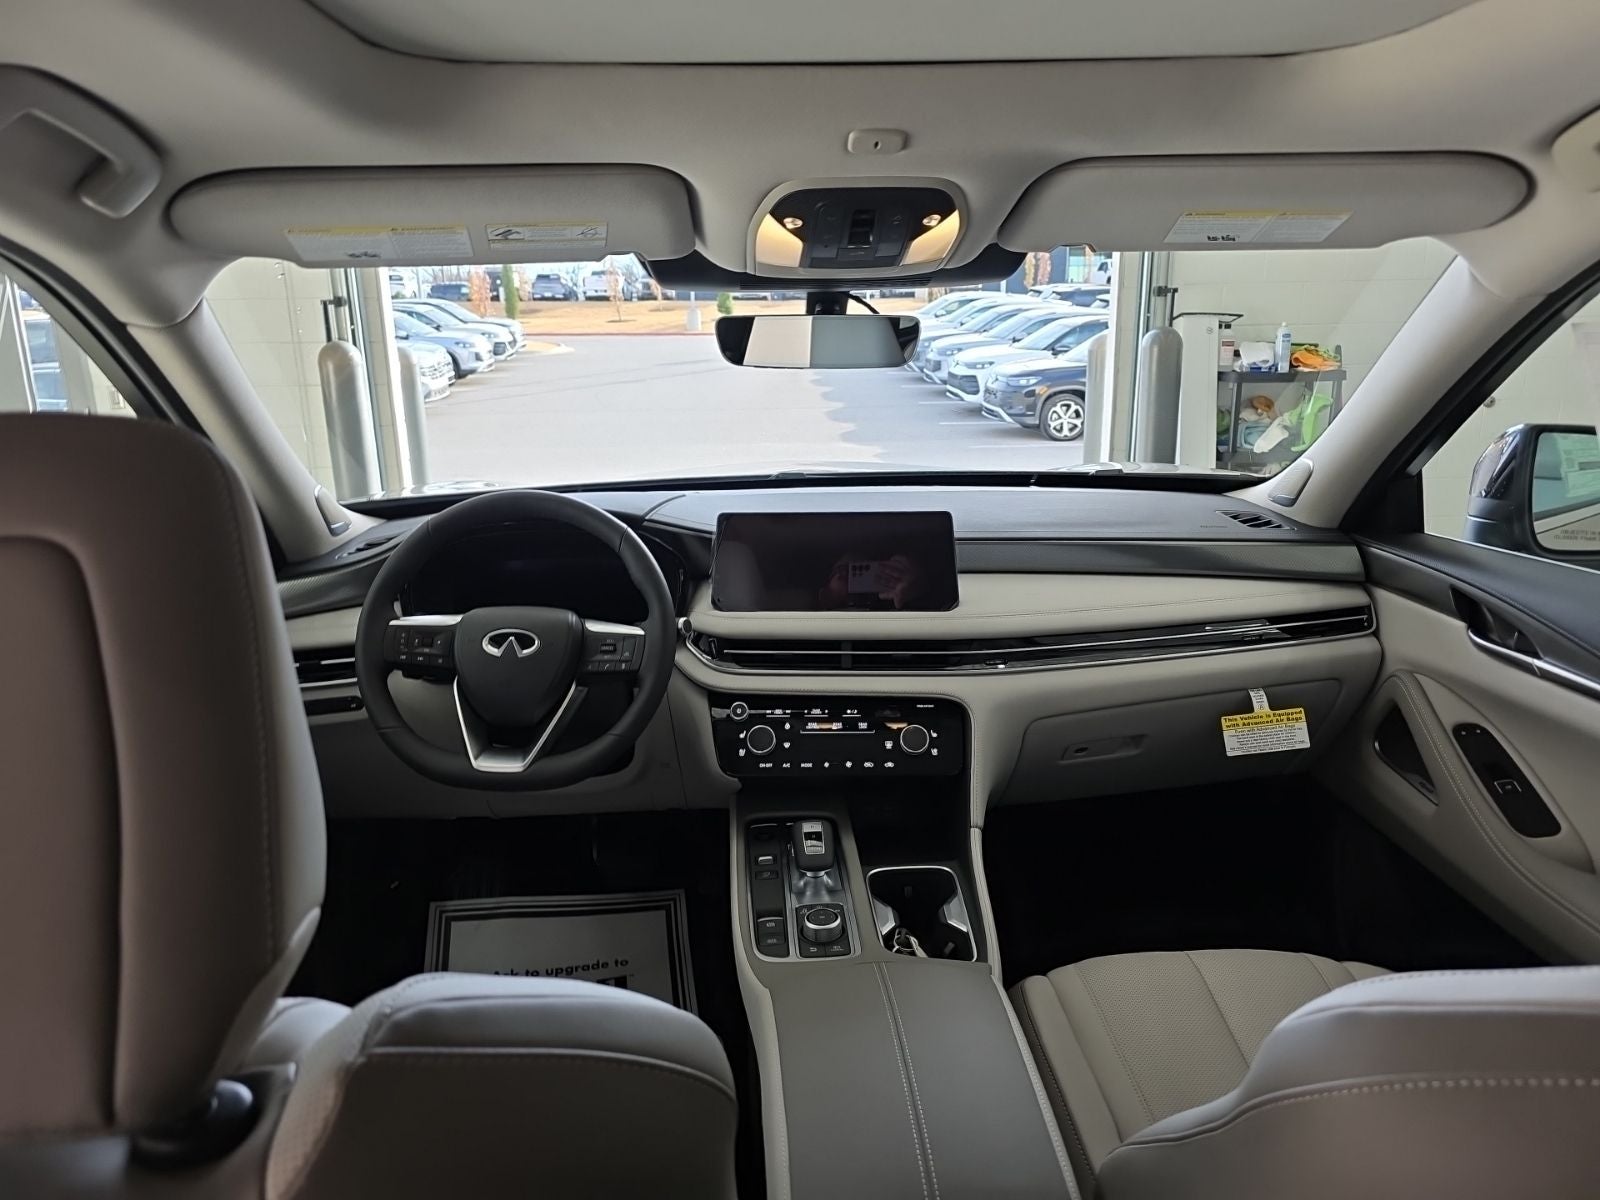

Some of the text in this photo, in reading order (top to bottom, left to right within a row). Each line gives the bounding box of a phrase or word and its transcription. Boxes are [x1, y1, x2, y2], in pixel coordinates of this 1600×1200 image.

[1273, 709, 1303, 718] Equipped
[1242, 719, 1274, 727] Advanced
[525, 969, 540, 977] to
[545, 960, 609, 977] upgrade
[614, 958, 629, 968] to
